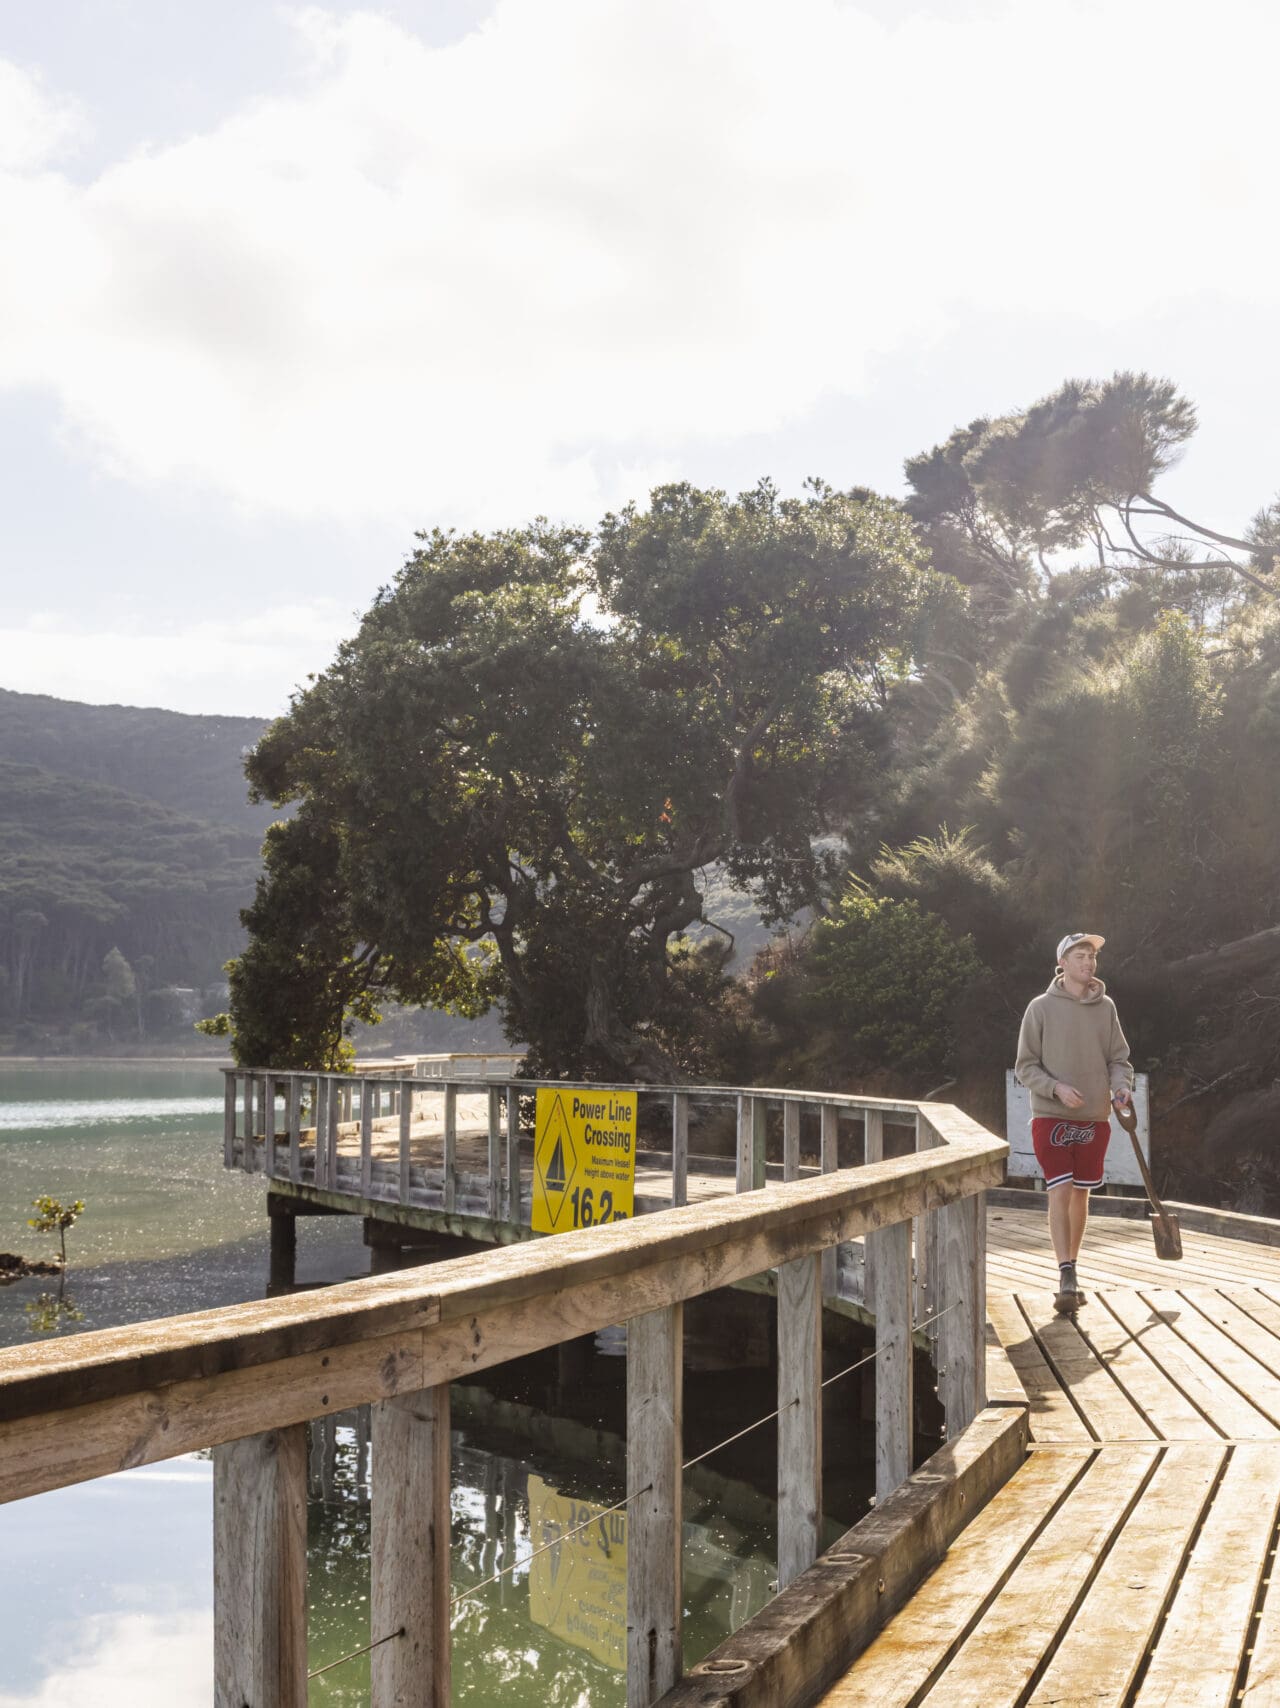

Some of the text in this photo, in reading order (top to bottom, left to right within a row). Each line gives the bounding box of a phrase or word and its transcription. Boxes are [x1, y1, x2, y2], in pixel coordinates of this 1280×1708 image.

[573, 1097, 632, 1122] Power Line
[584, 1123, 631, 1153] Crossing
[591, 1154, 613, 1166] Maximum
